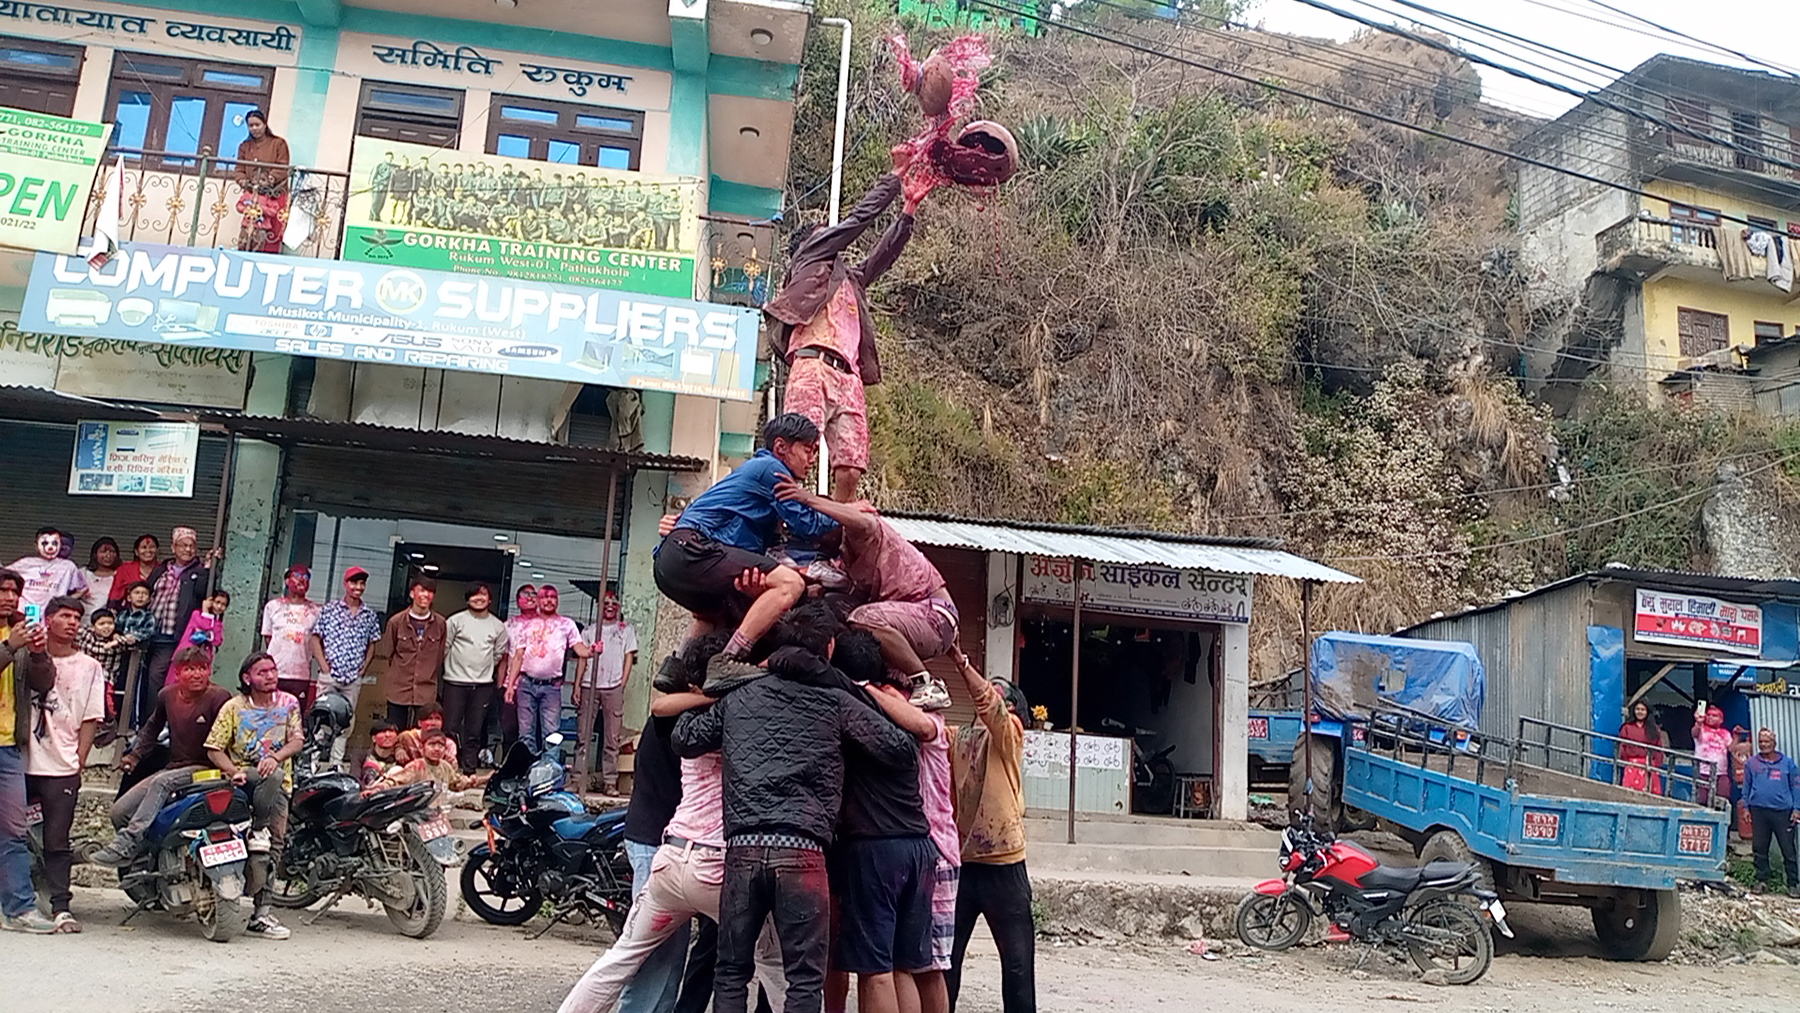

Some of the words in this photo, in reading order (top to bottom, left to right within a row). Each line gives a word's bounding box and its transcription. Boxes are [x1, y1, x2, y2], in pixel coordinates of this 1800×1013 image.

[165, 21, 296, 51] व्यवसायी
[371, 40, 503, 75] समिति
[519, 63, 633, 96] रुकुम
[2, 137, 48, 151] TRAINING
[51, 144, 85, 156] CENTER
[8, 128, 84, 147] GORKHA
[403, 232, 492, 254] GORKHA
[499, 241, 601, 264] TRAINING
[608, 252, 682, 272] CENTER
[449, 251, 495, 265] Rukum
[560, 262, 630, 278] Pathukhola
[53, 250, 365, 312] COMPUTER
[381, 278, 421, 303] MK
[434, 279, 739, 350] SUPPLIERS
[254, 319, 299, 330] TOSHIBA
[268, 305, 324, 320] Musikot
[432, 322, 478, 335] Rukum
[482, 324, 526, 341] (West)
[380, 333, 443, 348] ASUS
[451, 336, 494, 347] SONY
[452, 343, 492, 354] VAIO
[275, 338, 345, 356] SALES
[353, 345, 396, 361] AND
[404, 350, 510, 371] REPAIRING
[1681, 839, 1709, 851] 3717
